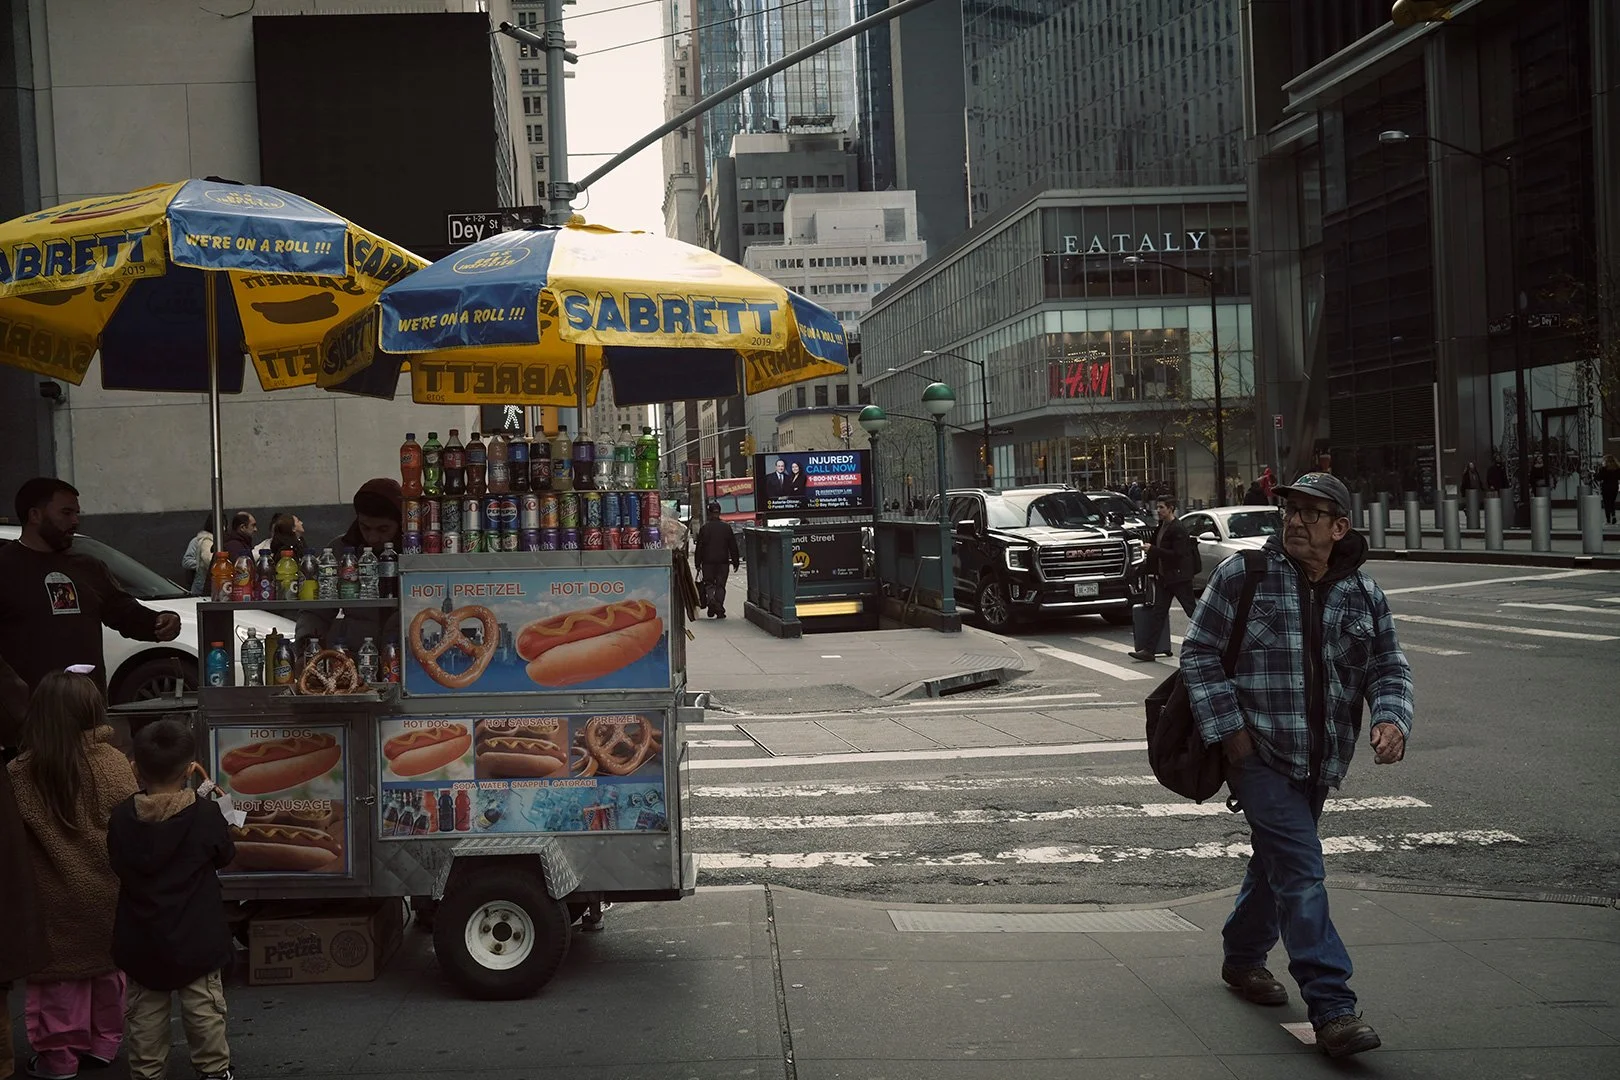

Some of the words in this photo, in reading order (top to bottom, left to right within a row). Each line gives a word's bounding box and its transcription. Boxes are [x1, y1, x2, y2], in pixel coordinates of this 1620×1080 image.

[452, 220, 485, 242] Dey
[489, 219, 498, 229] St
[185, 234, 231, 250] WE'RE
[236, 237, 256, 252] ON
[260, 239, 270, 252] A
[275, 240, 309, 254] ROLL
[314, 242, 332, 255] !!!
[1064, 231, 1206, 254] EATALY
[0, 226, 152, 284] ABRETT
[122, 265, 146, 275] 2019
[560, 289, 778, 335] SABRETT
[397, 314, 437, 333] WE'RE
[440, 313, 458, 327] ON
[459, 310, 469, 324] A
[473, 308, 505, 324] ROLL
[508, 306, 526, 321] !!!
[751, 336, 771, 346] 2019
[808, 455, 854, 465] INJURED?
[806, 465, 831, 474] CALL
[832, 464, 857, 473] NOW
[808, 474, 857, 482] 1-800-NY-LEGAL
[811, 533, 835, 543] Street
[1065, 548, 1103, 559] GMC
[795, 555, 807, 564] W
[411, 584, 445, 597] HOT
[453, 583, 526, 597] PRETZEL
[551, 582, 585, 595] HOT
[588, 581, 625, 595] DOG
[403, 720, 426, 728] HOT
[427, 719, 450, 728] DOG
[485, 718, 508, 728] HOT
[509, 717, 559, 728] SAUSAGE
[593, 715, 640, 725] PRETZEL
[250, 729, 278, 739] HOT
[282, 729, 313, 739] DOG
[453, 782, 477, 790] SODA
[479, 781, 509, 790] WATER
[511, 780, 550, 789] SNAPPLE
[552, 778, 598, 788] GATORADE
[233, 800, 262, 812] HOT
[263, 799, 332, 812] SAUSAGE
